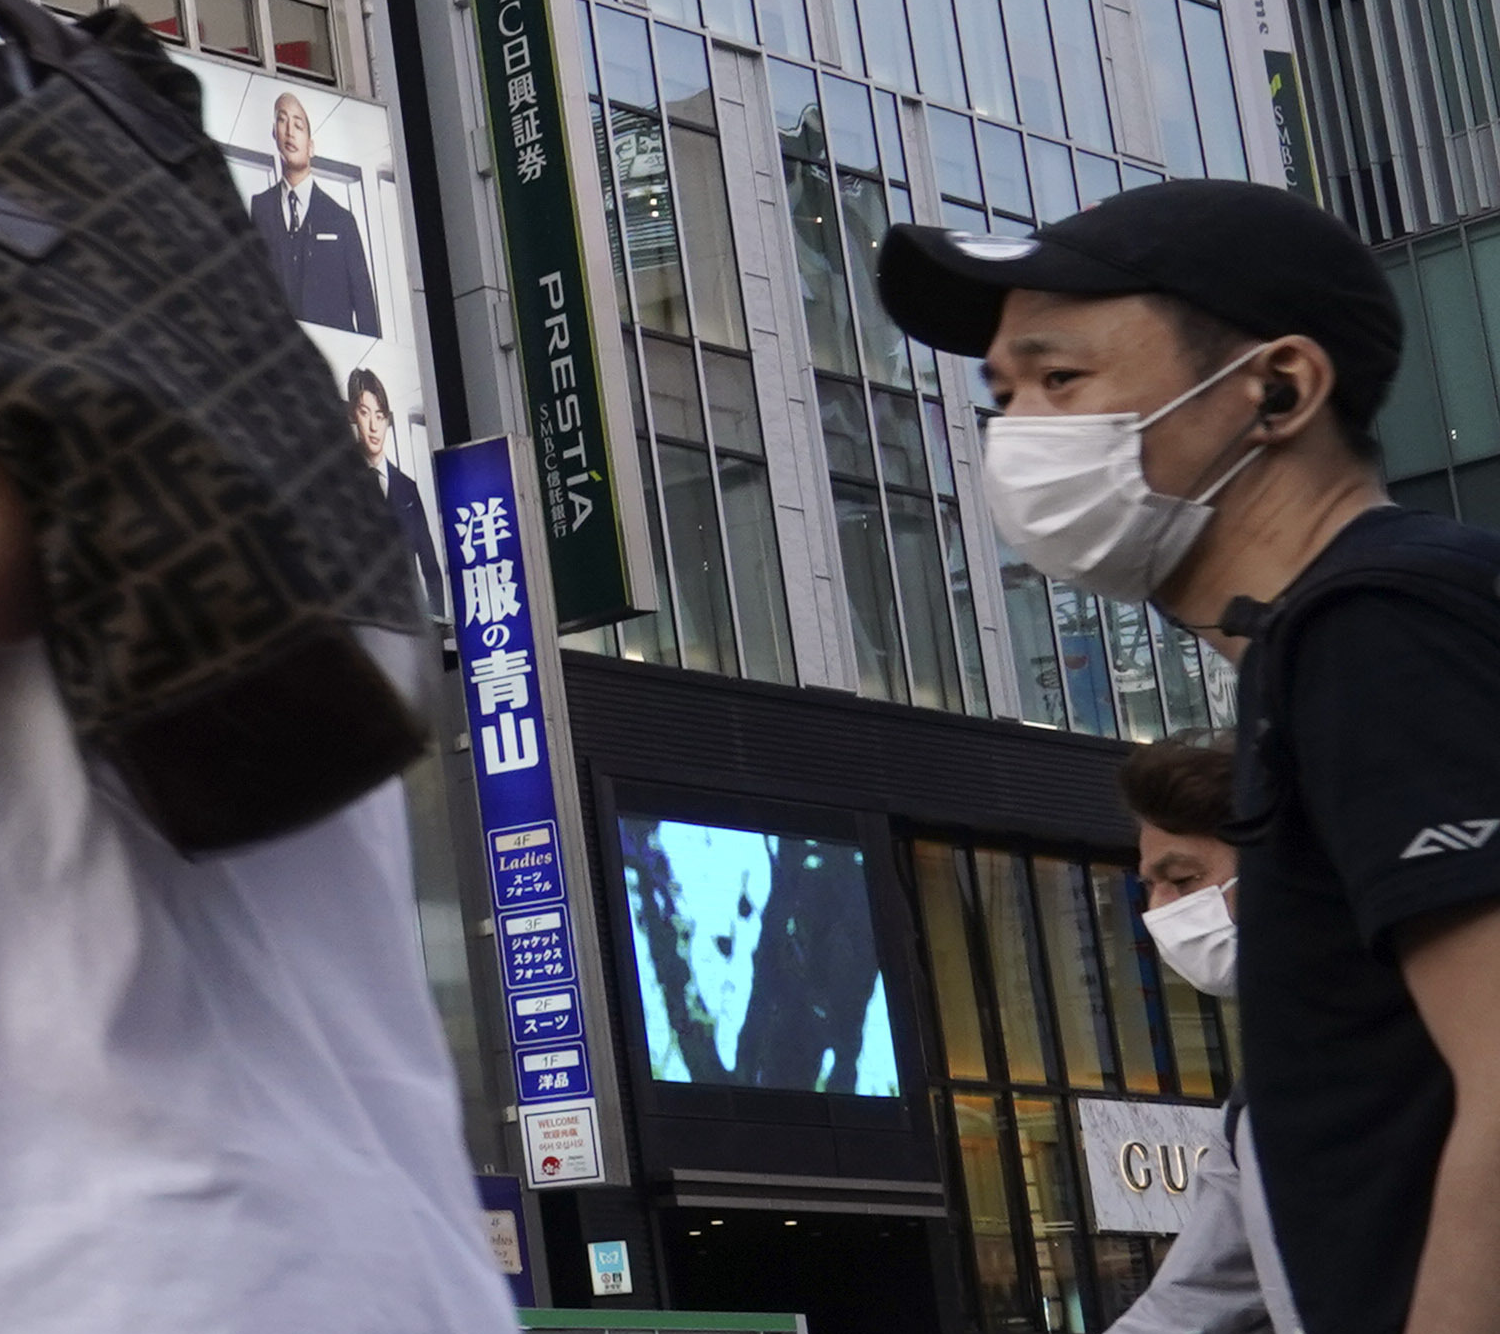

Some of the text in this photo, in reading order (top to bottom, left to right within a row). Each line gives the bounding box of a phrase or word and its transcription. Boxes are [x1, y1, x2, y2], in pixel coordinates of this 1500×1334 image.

[454, 496, 540, 776] 洋服の青山
[514, 834, 531, 847] 4F
[499, 851, 553, 872] Ladies
[513, 871, 542, 886] スーツ
[525, 917, 542, 932] 3F
[512, 933, 559, 951] ジャケット
[513, 948, 563, 966] スラックス
[535, 998, 552, 1013] 2F
[523, 1014, 569, 1035] スーツ
[542, 1055, 560, 1068] 1F
[538, 1072, 570, 1091] 洋品
[537, 1116, 580, 1129] WELCOME
